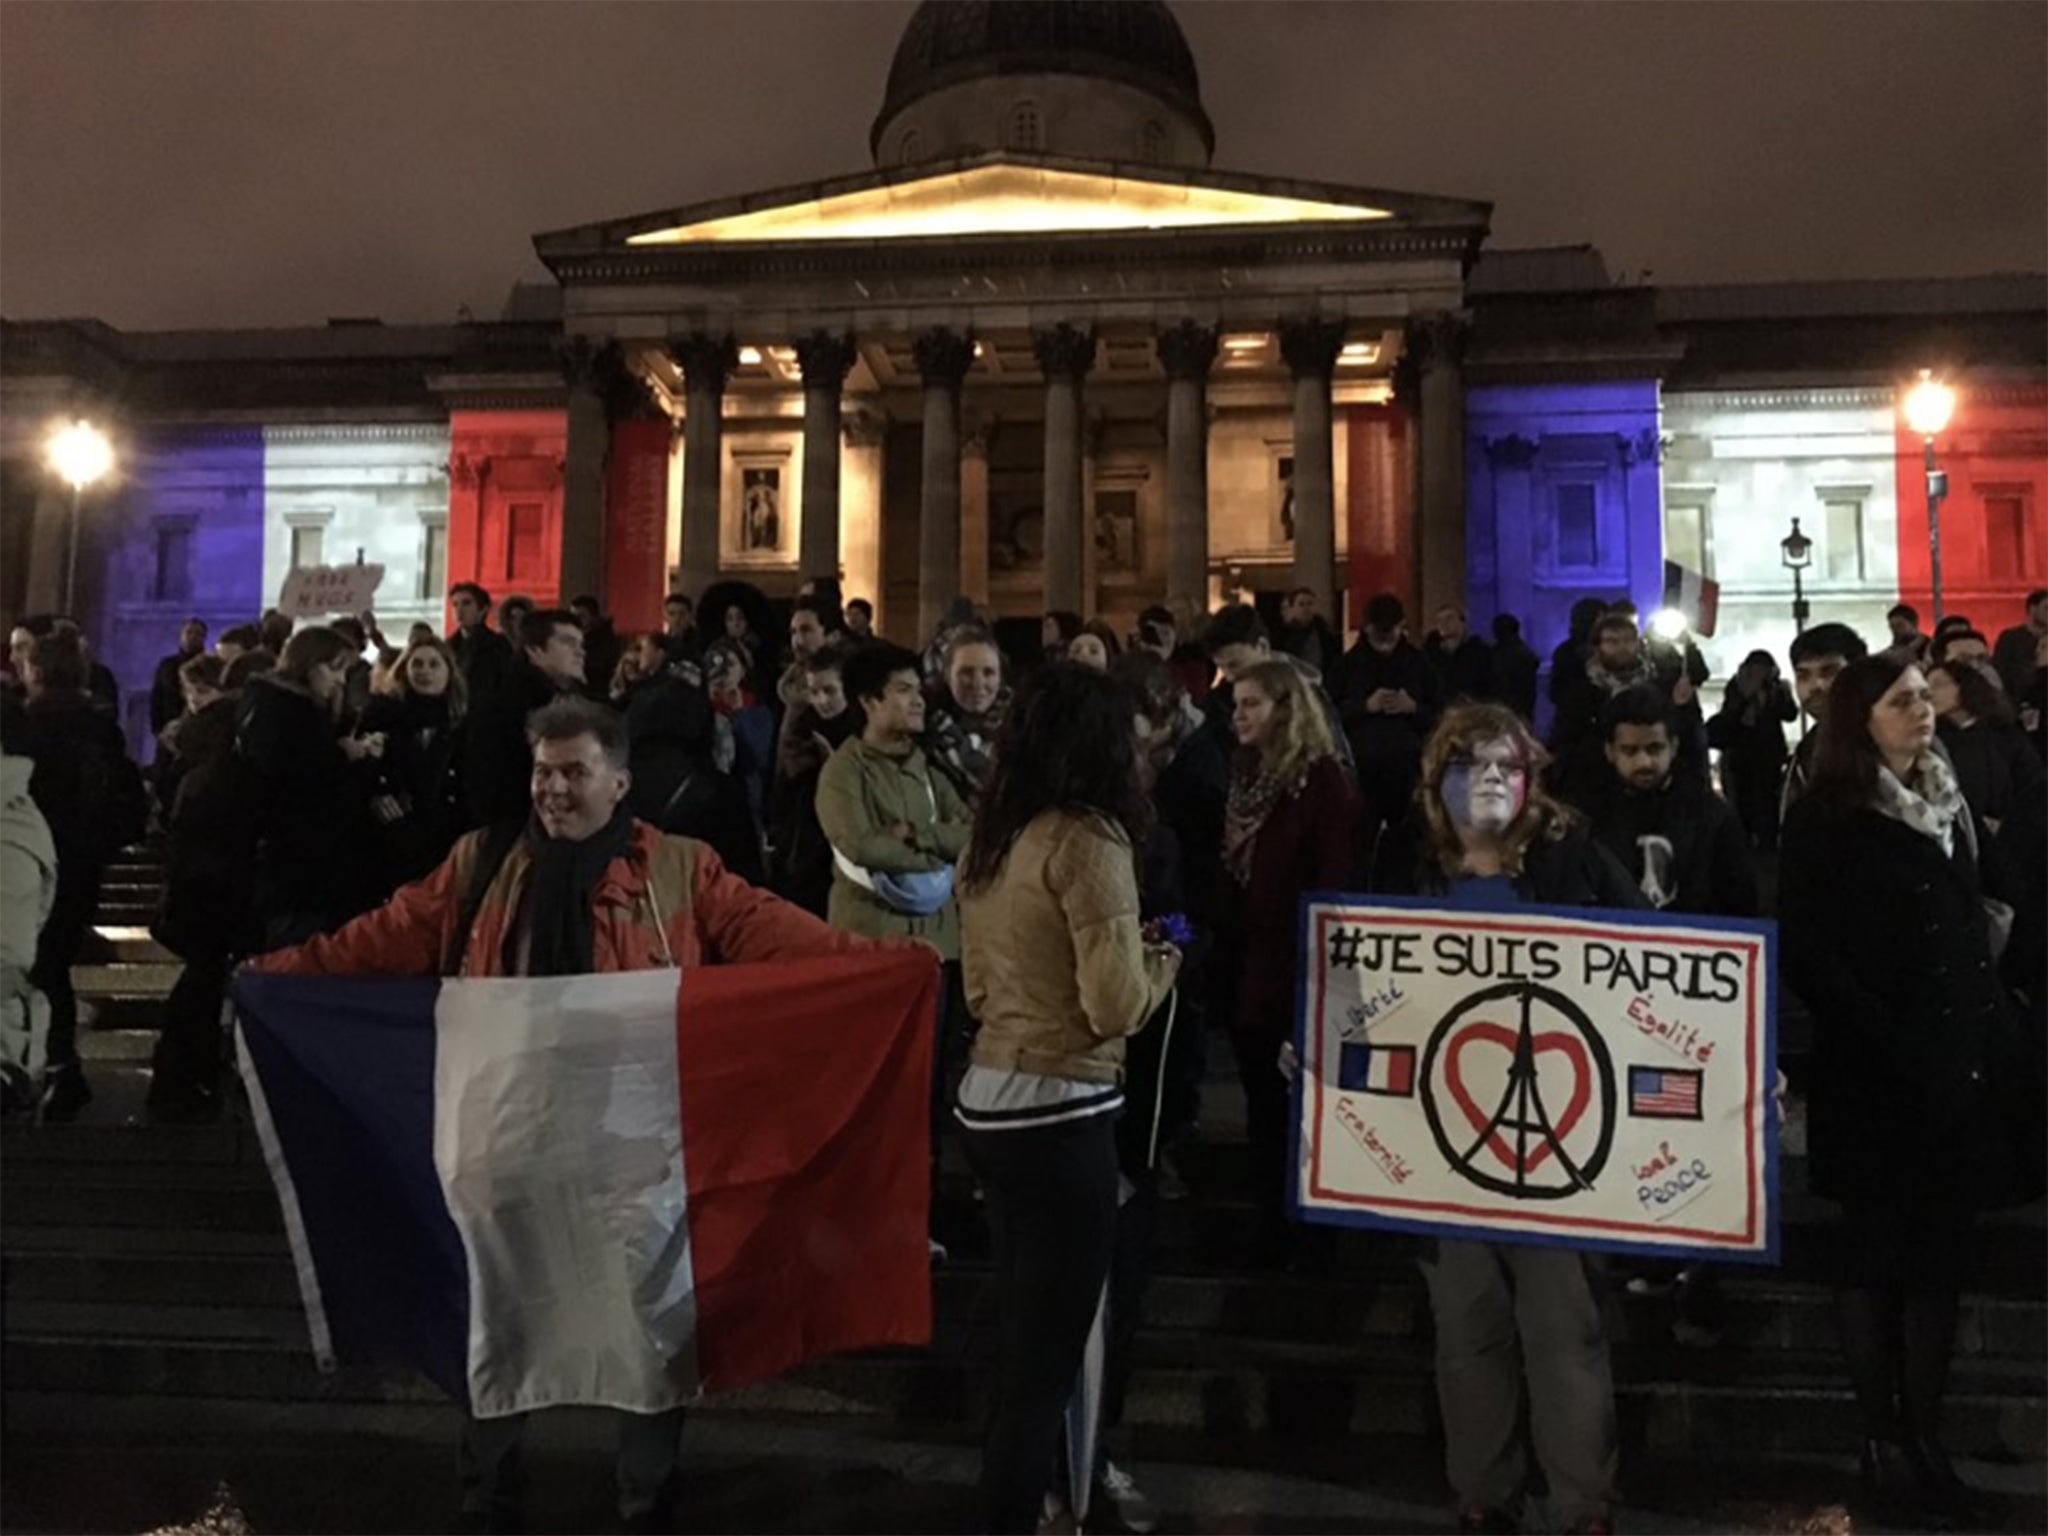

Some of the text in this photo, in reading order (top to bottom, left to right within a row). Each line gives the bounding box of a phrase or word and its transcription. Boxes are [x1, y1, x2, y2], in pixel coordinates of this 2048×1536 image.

[1329, 926, 1742, 1002] #JE SUIS PARIS
[1626, 994, 1715, 1062] Égalité
